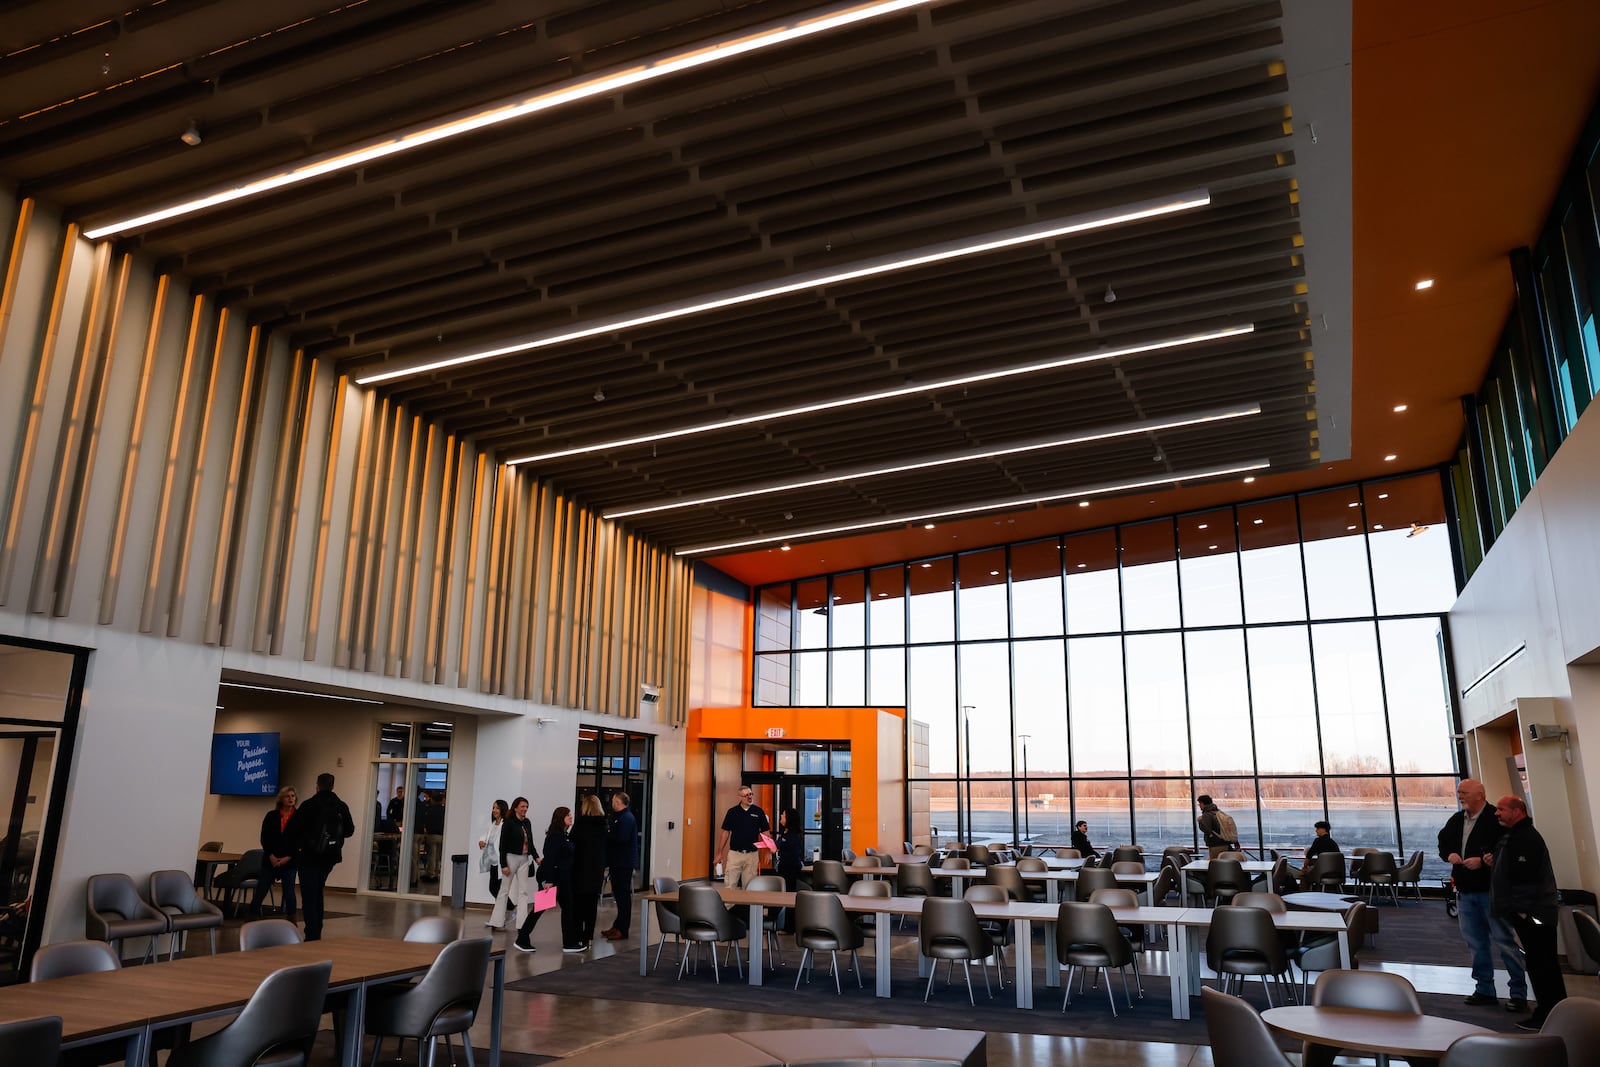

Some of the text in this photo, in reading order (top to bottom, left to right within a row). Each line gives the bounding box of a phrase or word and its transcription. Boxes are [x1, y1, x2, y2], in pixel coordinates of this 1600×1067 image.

[236, 740, 250, 748] YOUR
[243, 746, 268, 759] Passion.
[237, 758, 264, 771] Purpose.
